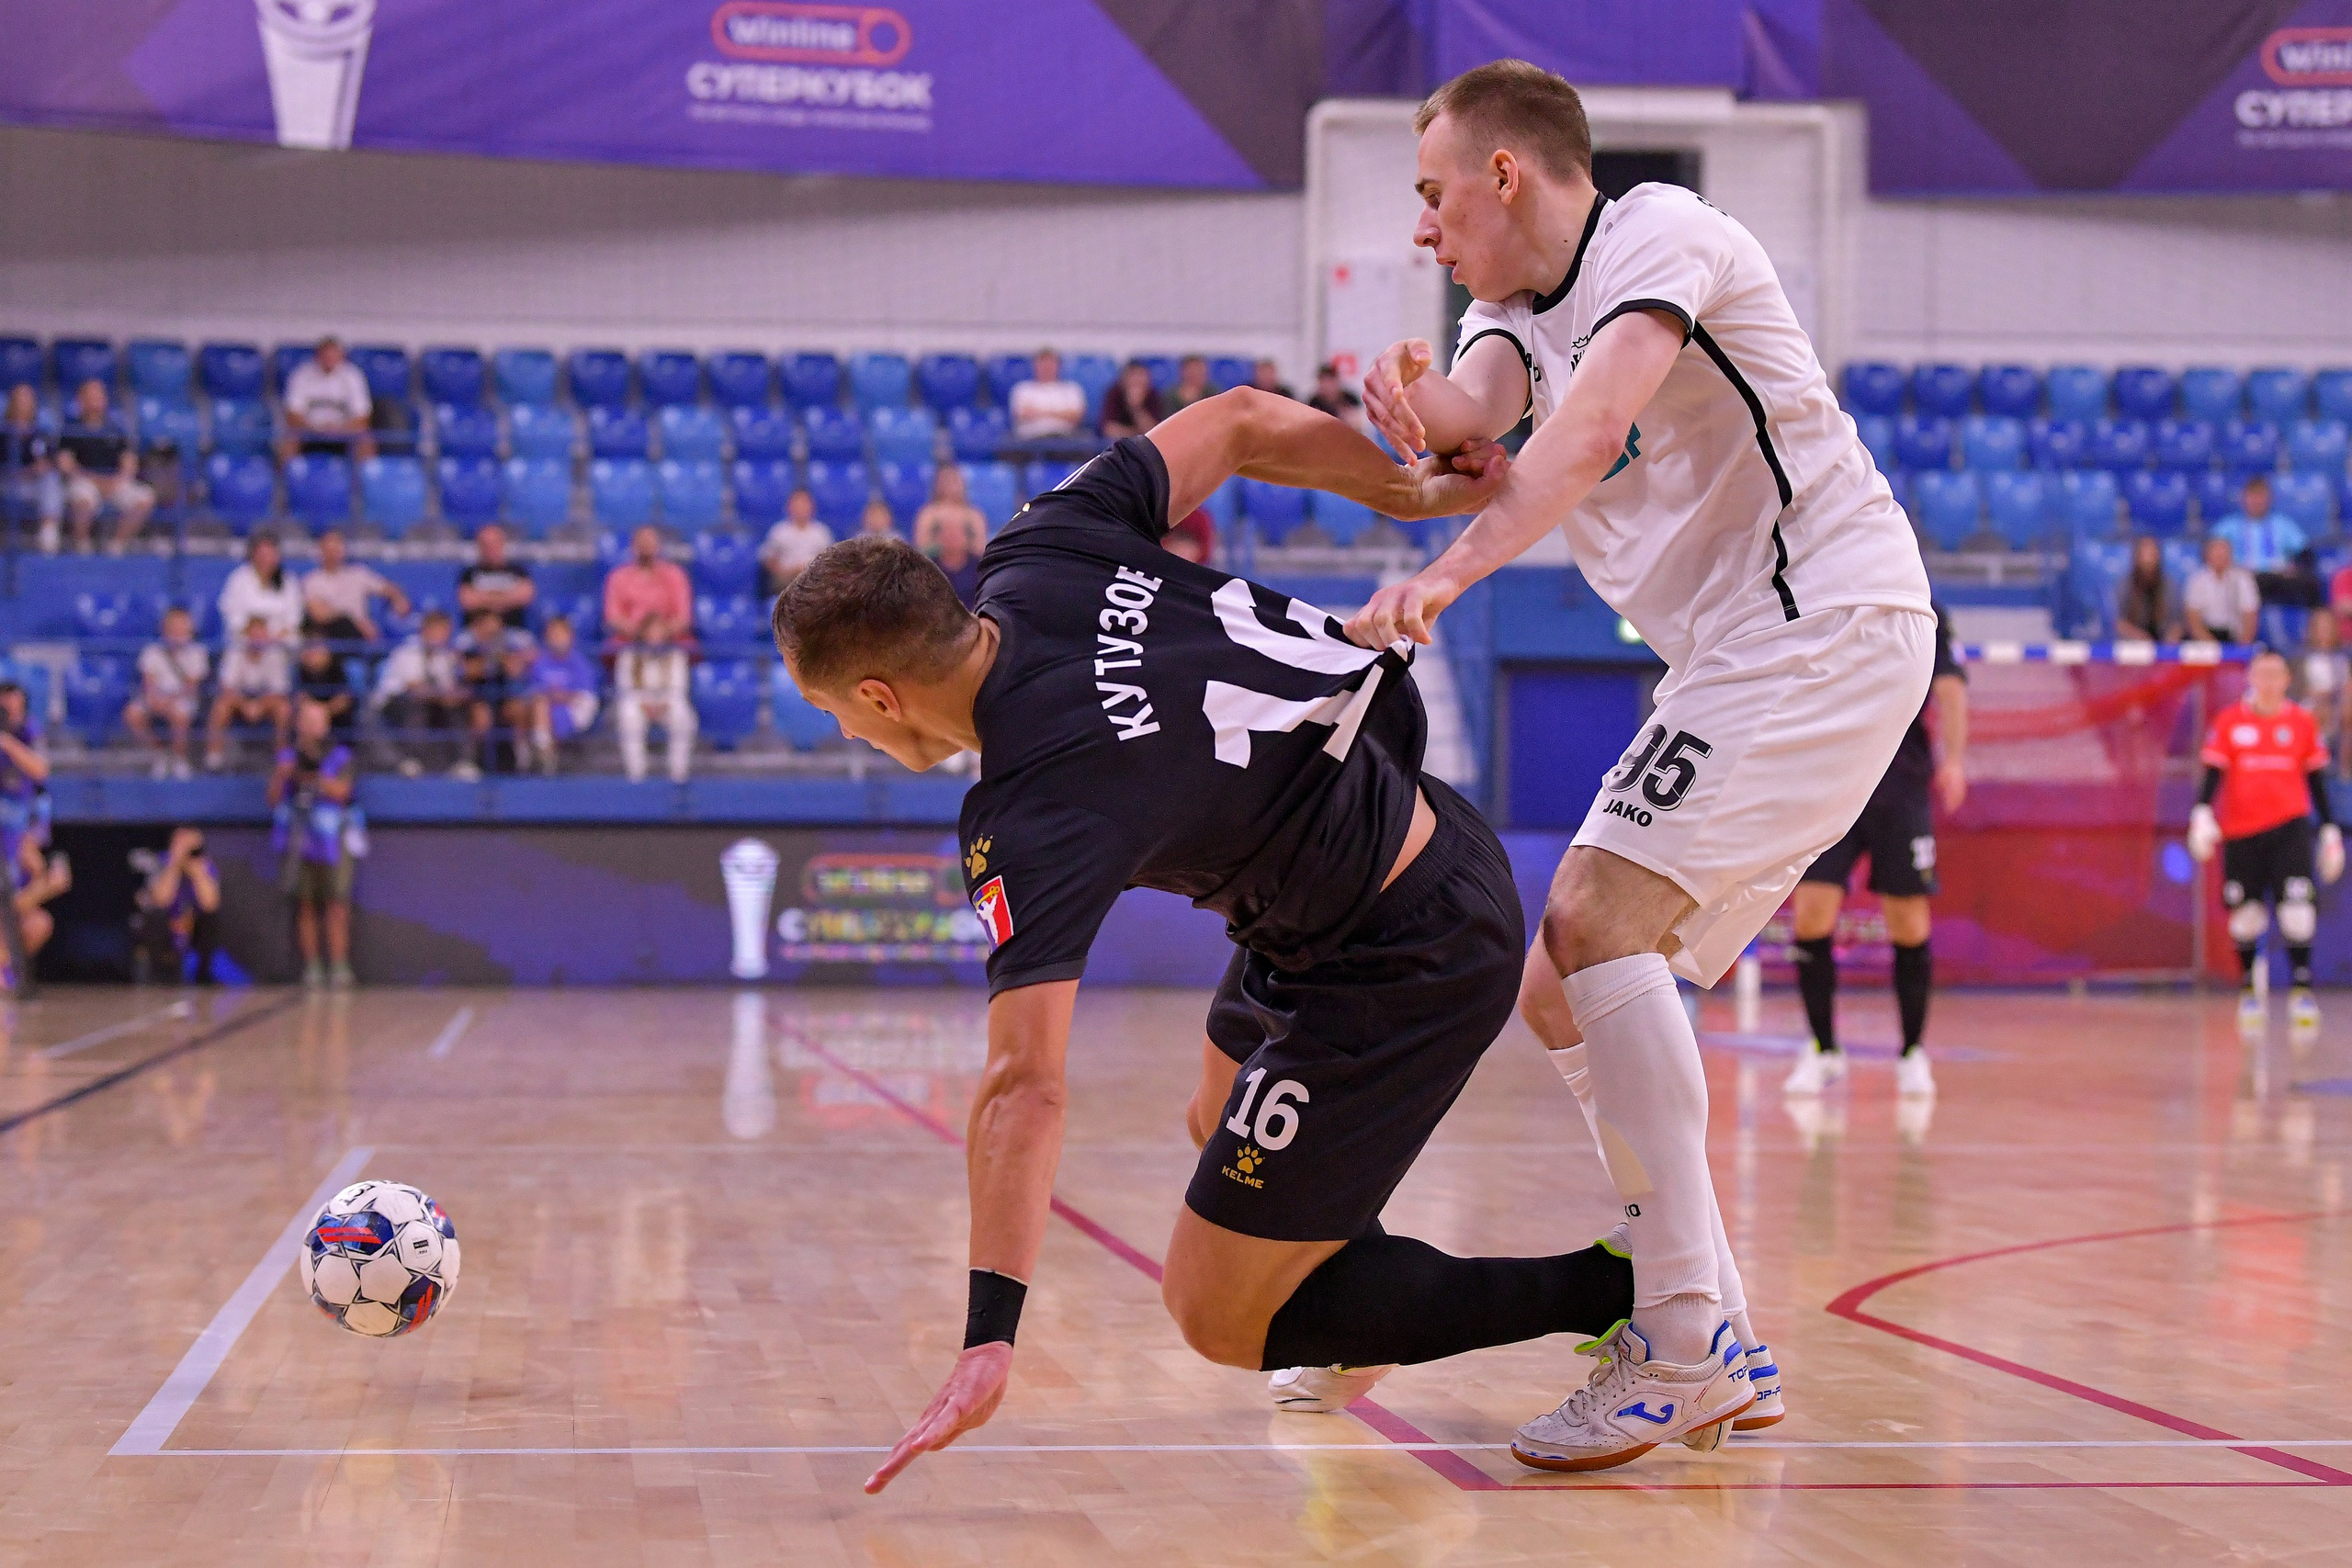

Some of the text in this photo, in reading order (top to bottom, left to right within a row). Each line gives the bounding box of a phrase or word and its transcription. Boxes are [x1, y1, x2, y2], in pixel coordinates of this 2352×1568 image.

[685, 61, 933, 109] СУПЕРКУБОК
[1608, 724, 1713, 811] 95
[1602, 798, 1653, 828] JAKO
[1226, 1066, 1309, 1151] 16
[1221, 1165, 1265, 1190] KELME
